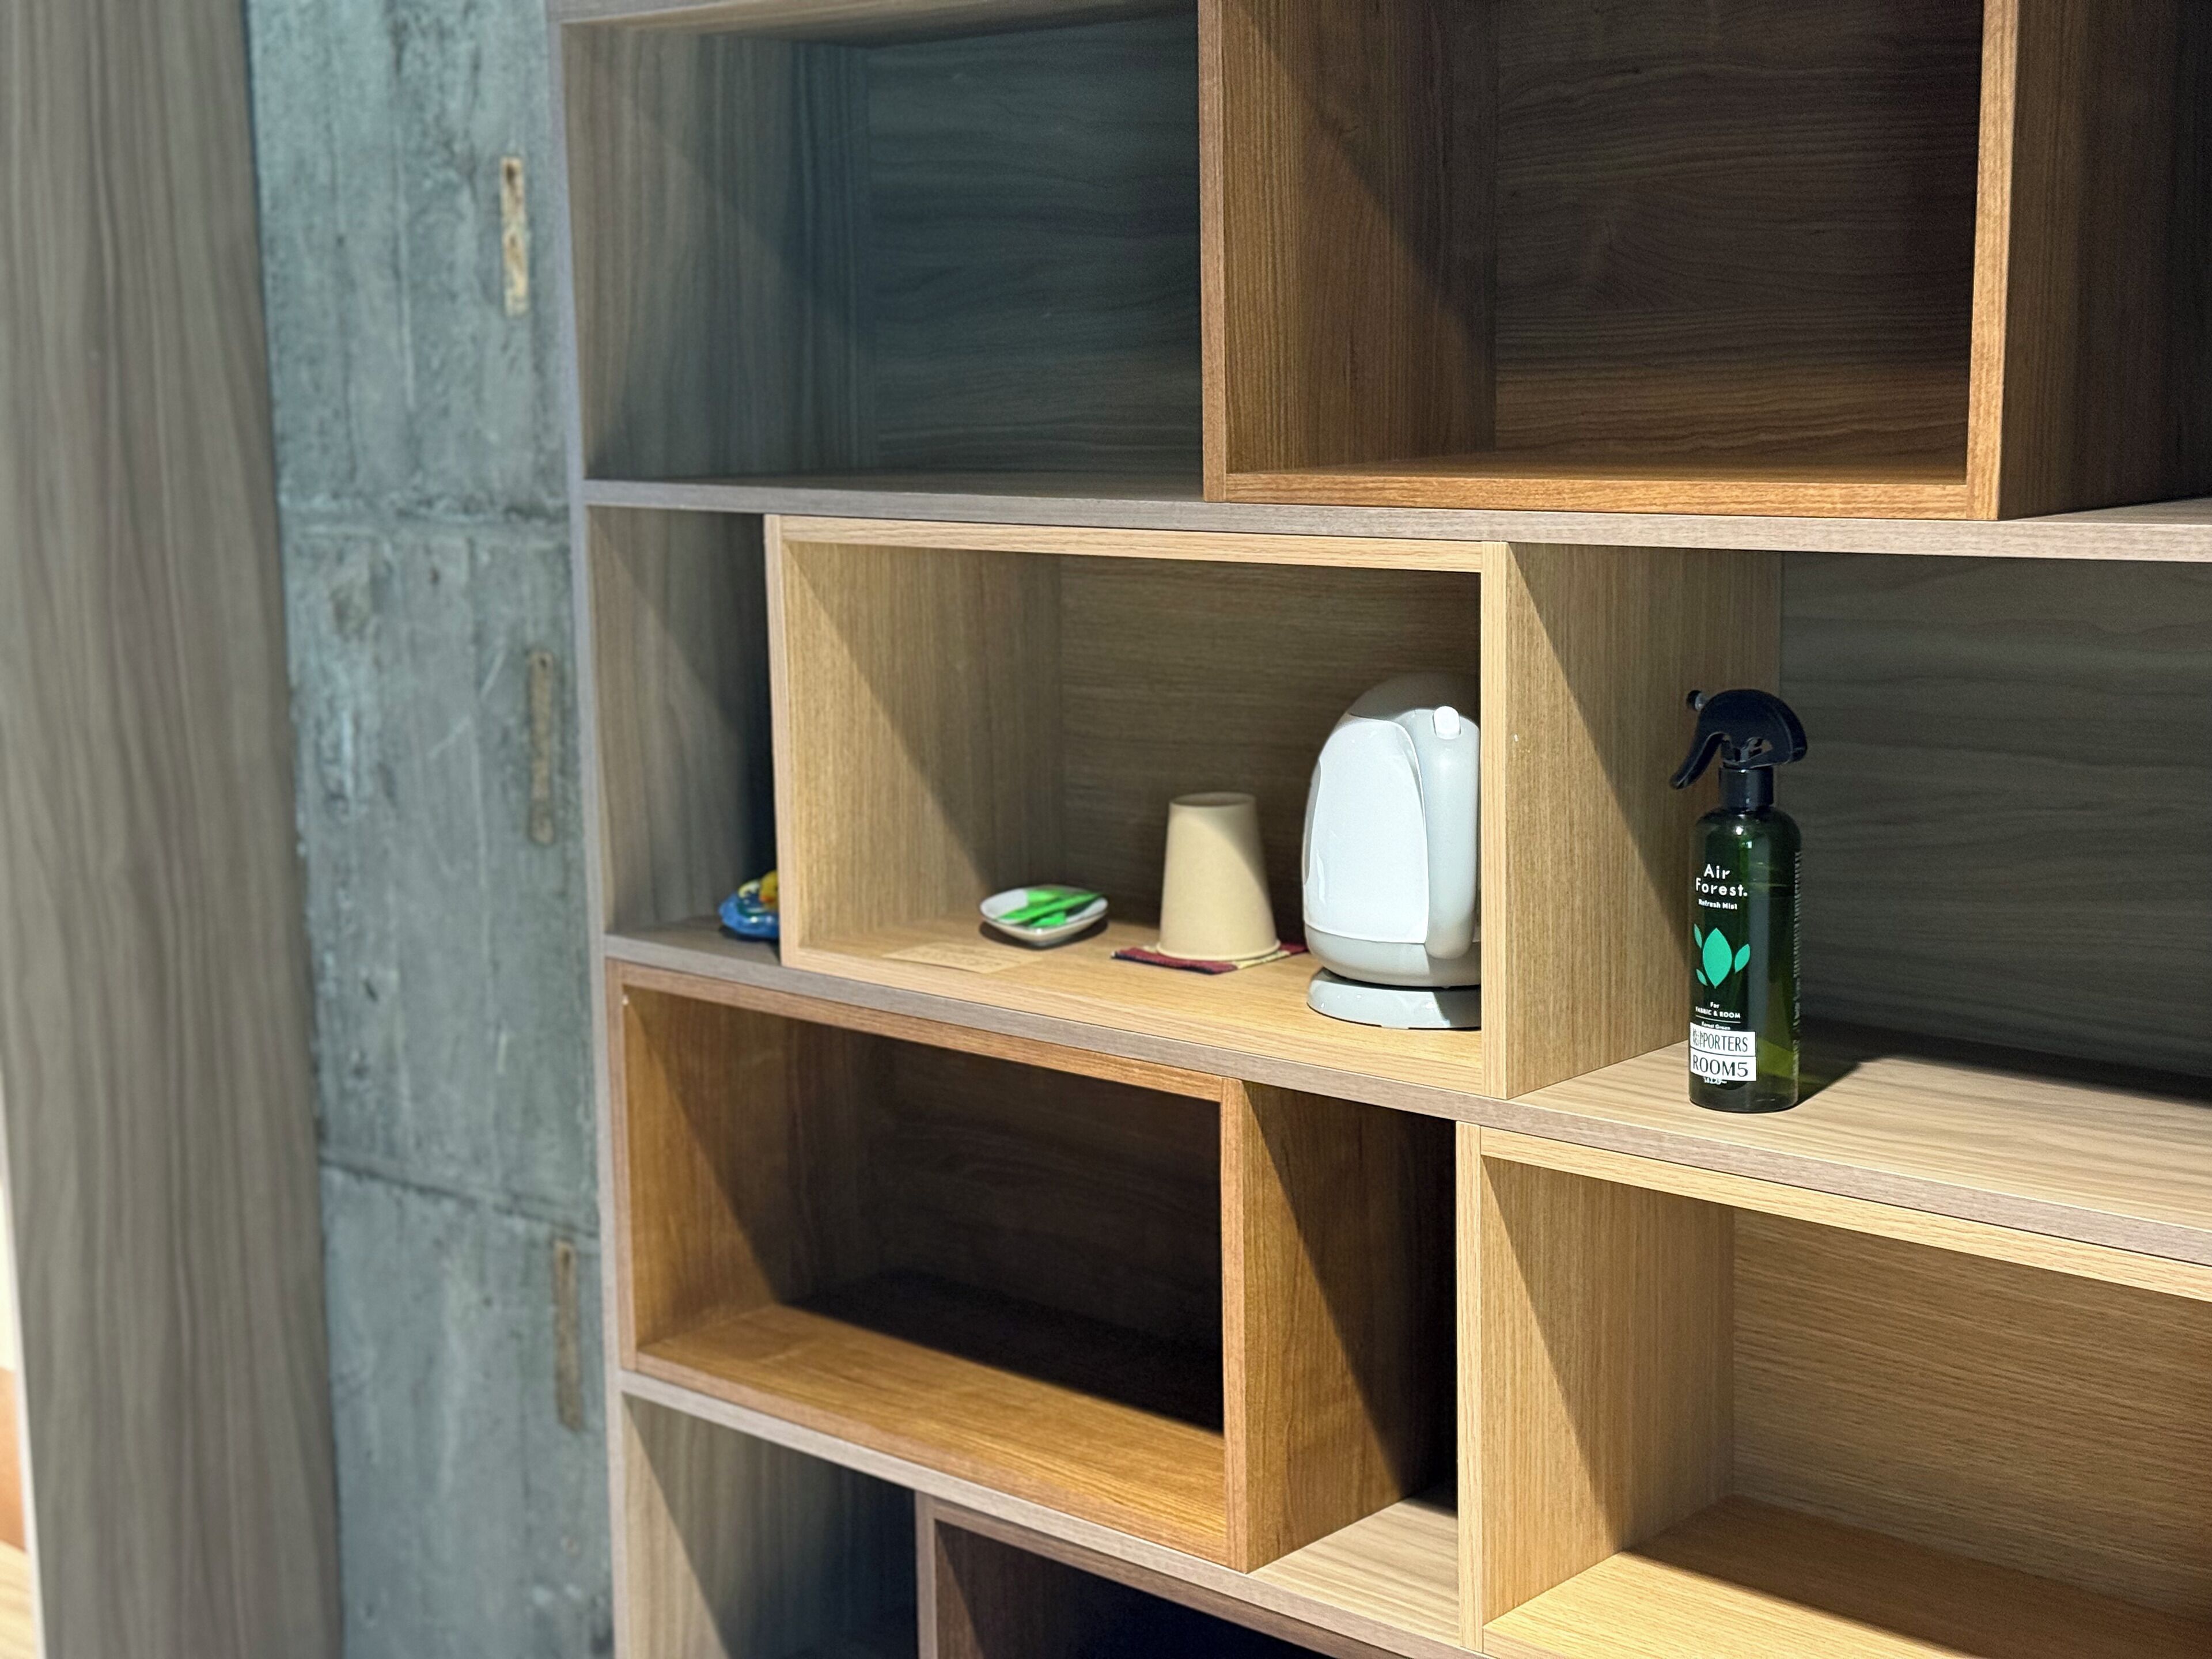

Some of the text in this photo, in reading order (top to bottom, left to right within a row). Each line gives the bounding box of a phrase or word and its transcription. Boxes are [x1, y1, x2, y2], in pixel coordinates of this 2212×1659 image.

[1704, 864, 1730, 879] Air
[1696, 877, 1748, 896] Forest.
[1693, 1055, 1748, 1077] ROOM5
